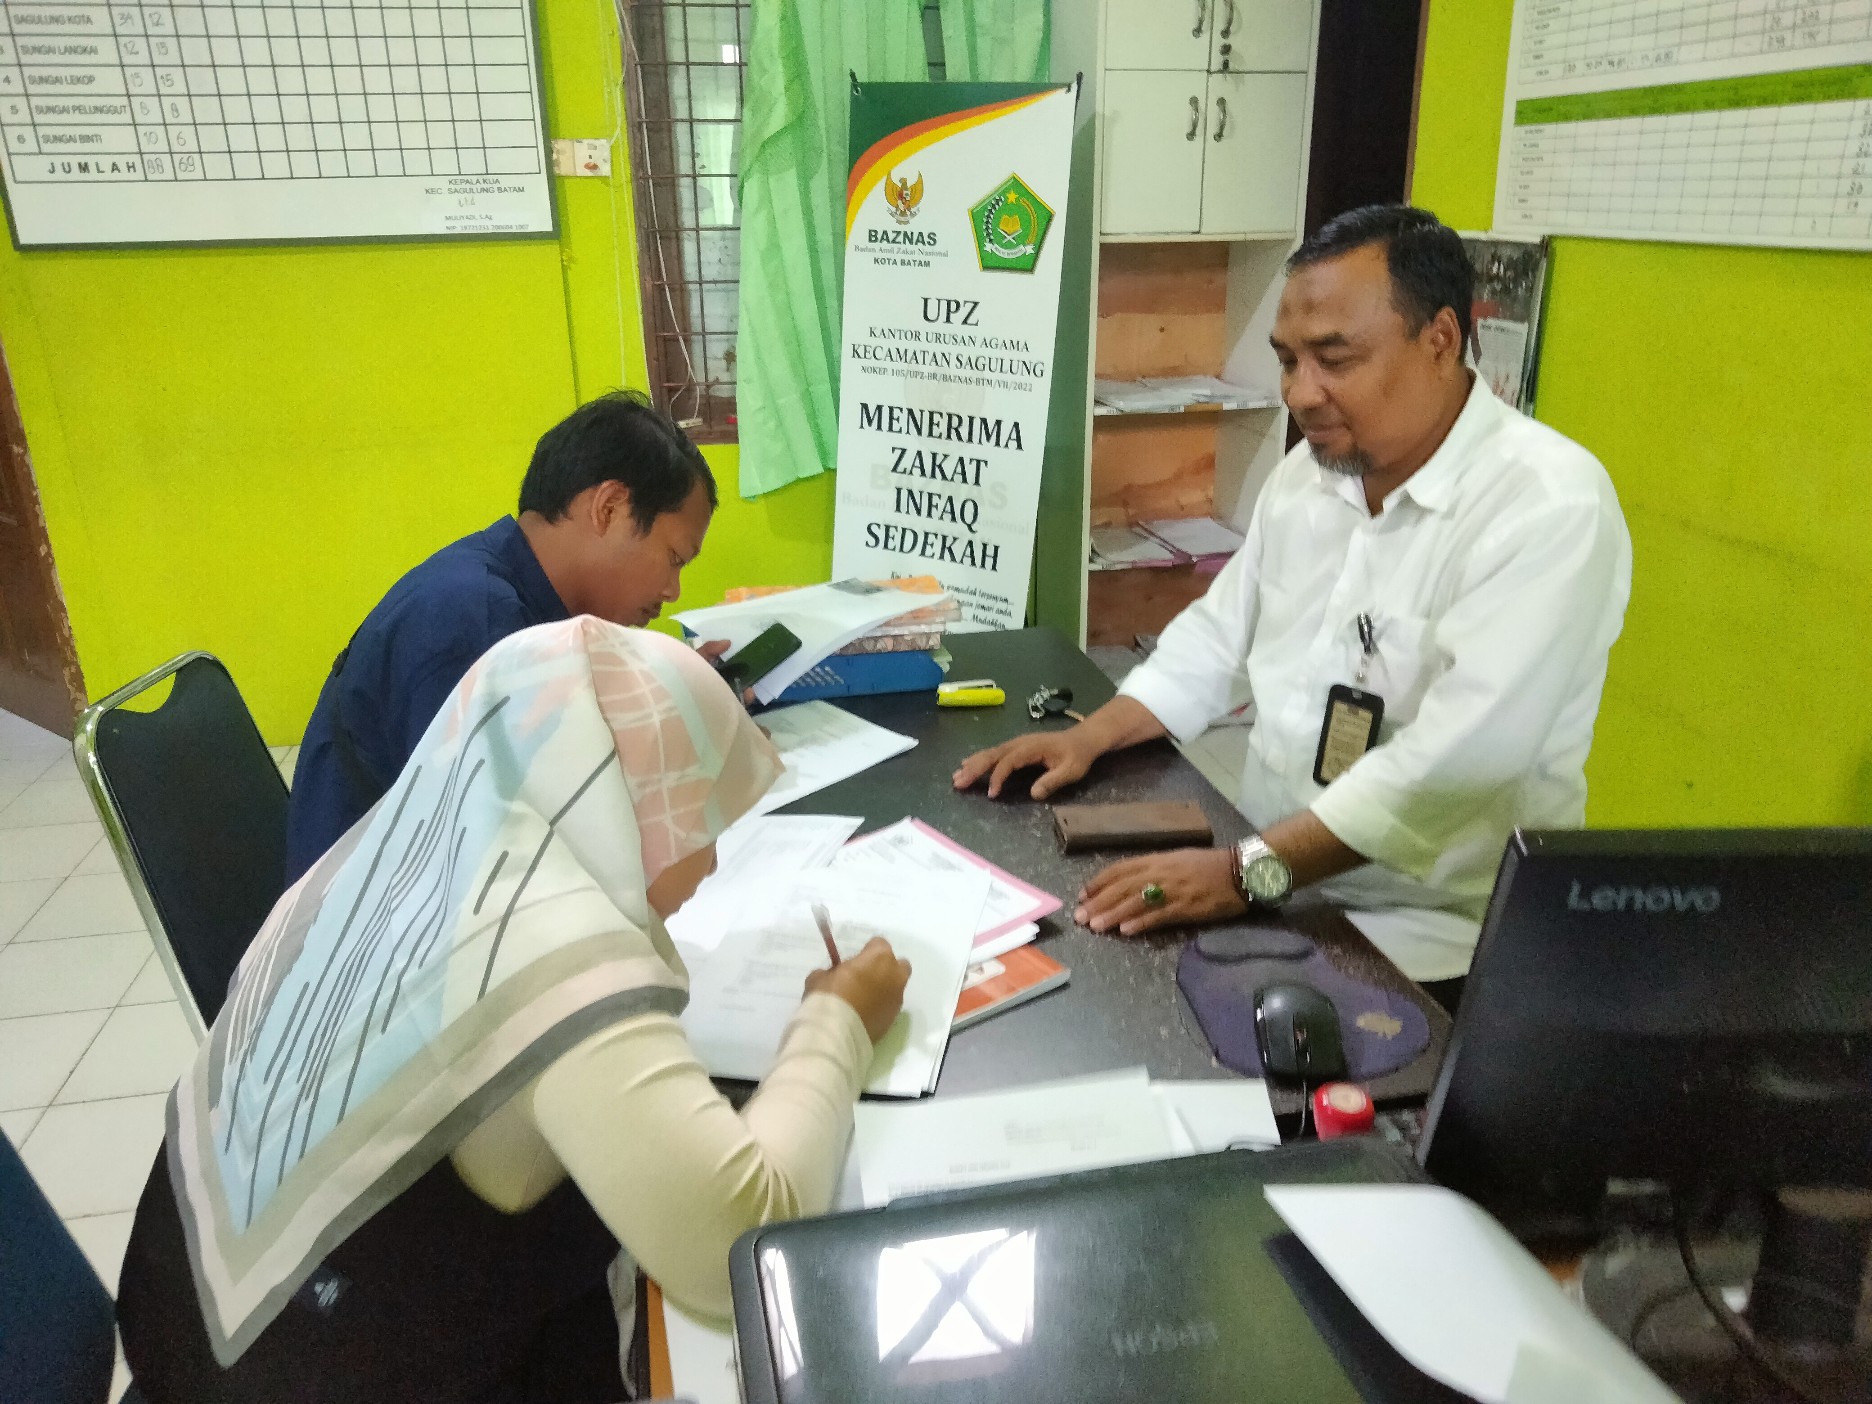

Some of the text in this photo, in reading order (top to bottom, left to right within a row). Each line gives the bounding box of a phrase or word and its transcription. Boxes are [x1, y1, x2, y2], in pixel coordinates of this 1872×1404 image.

[3, 75, 11, 85] 4
[28, 75, 96, 85] SUNGAI LEKOP
[160, 73, 174, 88] 15
[10, 105, 19, 115] 5
[35, 105, 71, 115] SUNGAI
[41, 134, 78, 144] SUNGAI
[176, 131, 187, 147] 6
[48, 161, 137, 174] JUMLAH
[448, 178, 501, 186] KEPALA KUA
[447, 187, 496, 195] SAGULUNG
[497, 186, 525, 194] BATAM
[868, 229, 937, 246] BAZNAS
[854, 245, 949, 258] Badan Amil Zakat Nasional
[873, 257, 931, 268] KOTA BATAM
[921, 297, 981, 327] UPZ
[869, 326, 1030, 353] KANTOR URUSAN AGAMA
[851, 343, 1045, 379] KECAMATAN SAGULUNG
[858, 402, 1024, 451] MENERIMA
[890, 446, 988, 487] ZAKAT
[894, 486, 980, 534] INFAQ
[865, 522, 1000, 572] SEDEKAH
[1567, 878, 1721, 912] Lenovo
